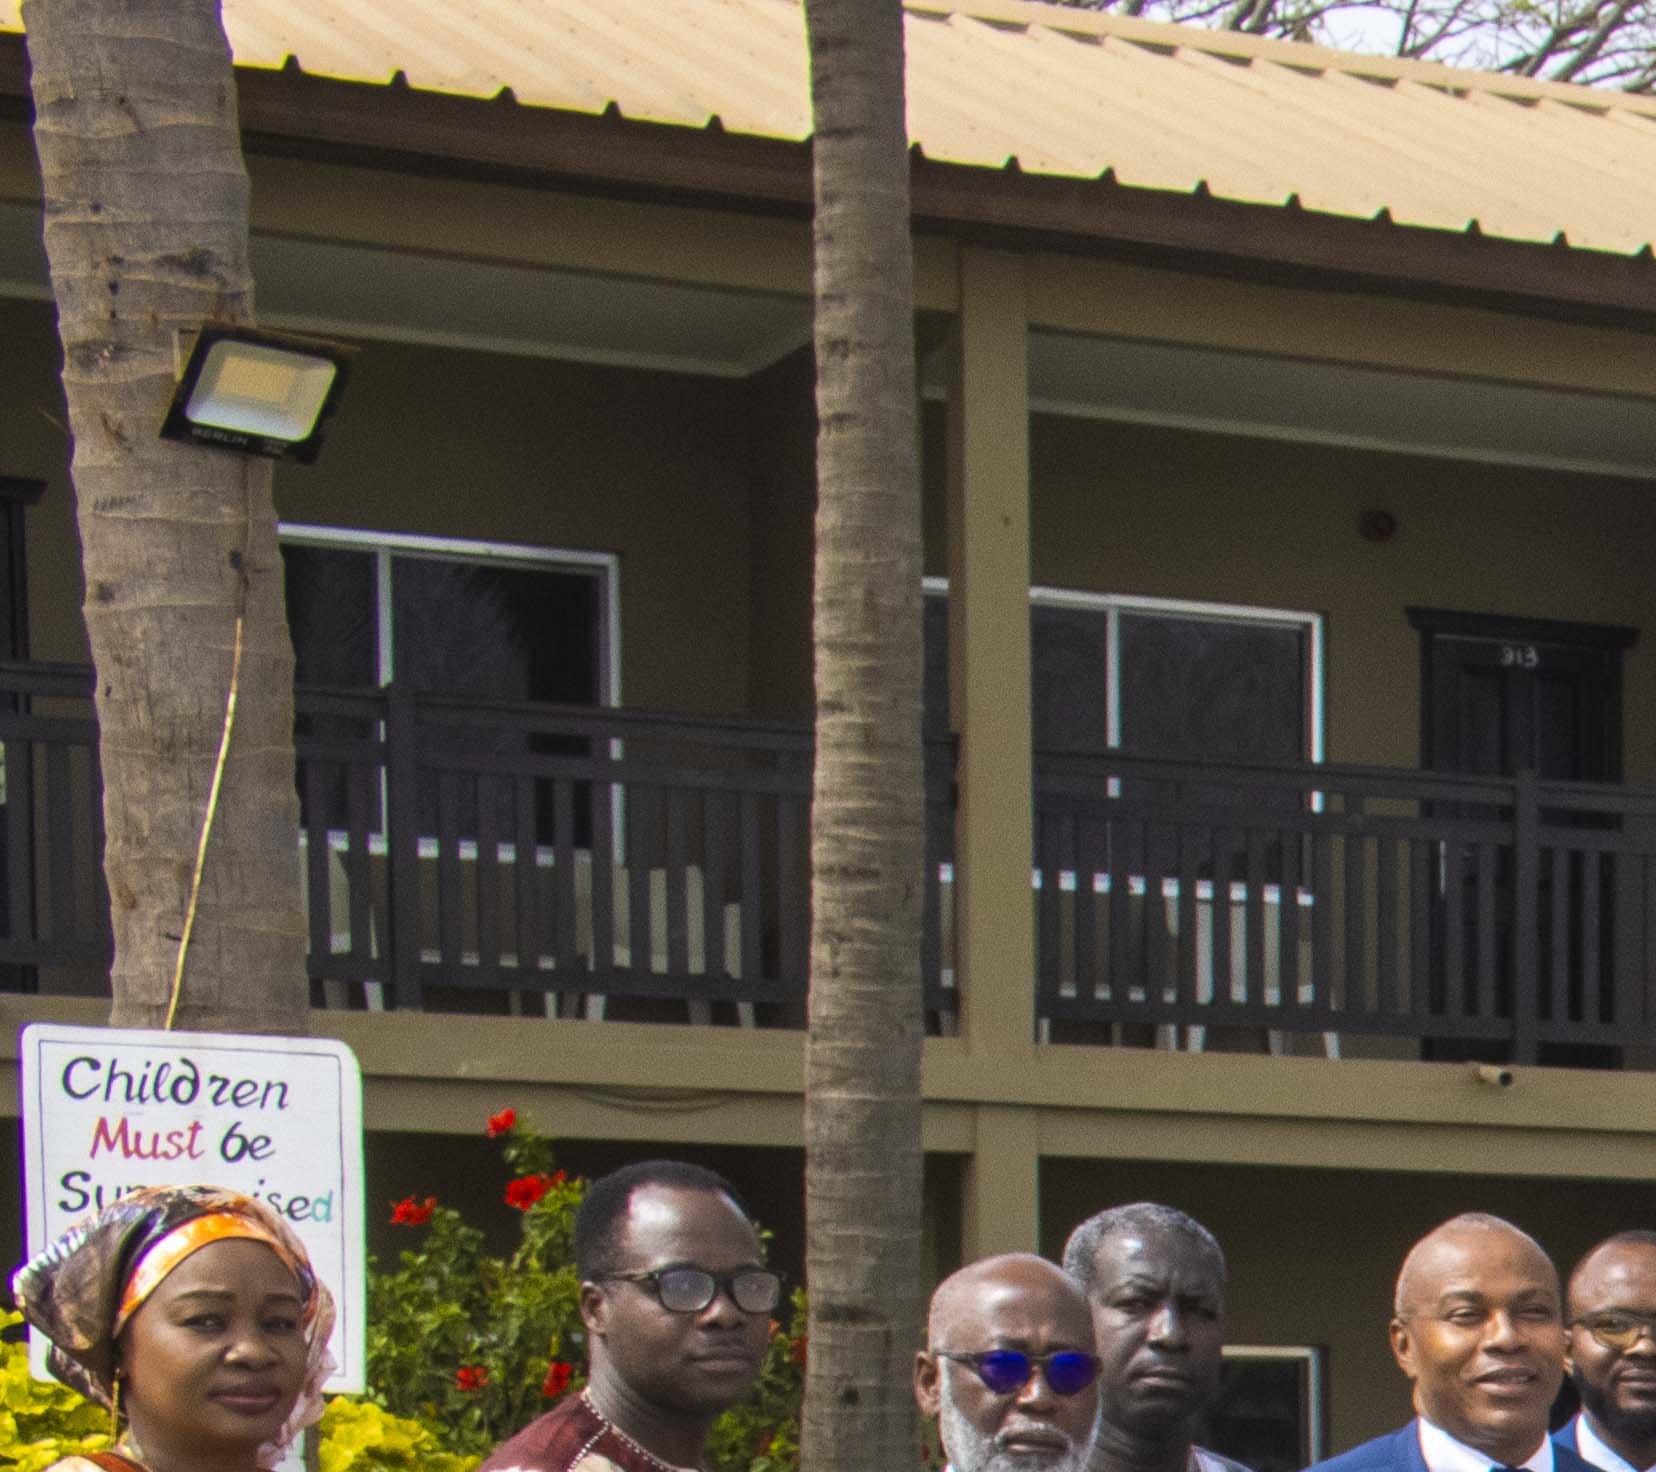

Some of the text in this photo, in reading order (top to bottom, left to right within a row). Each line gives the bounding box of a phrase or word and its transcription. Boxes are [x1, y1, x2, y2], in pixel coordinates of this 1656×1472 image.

[62, 1057, 288, 1109] Children
[90, 1116, 276, 1163] Must be
